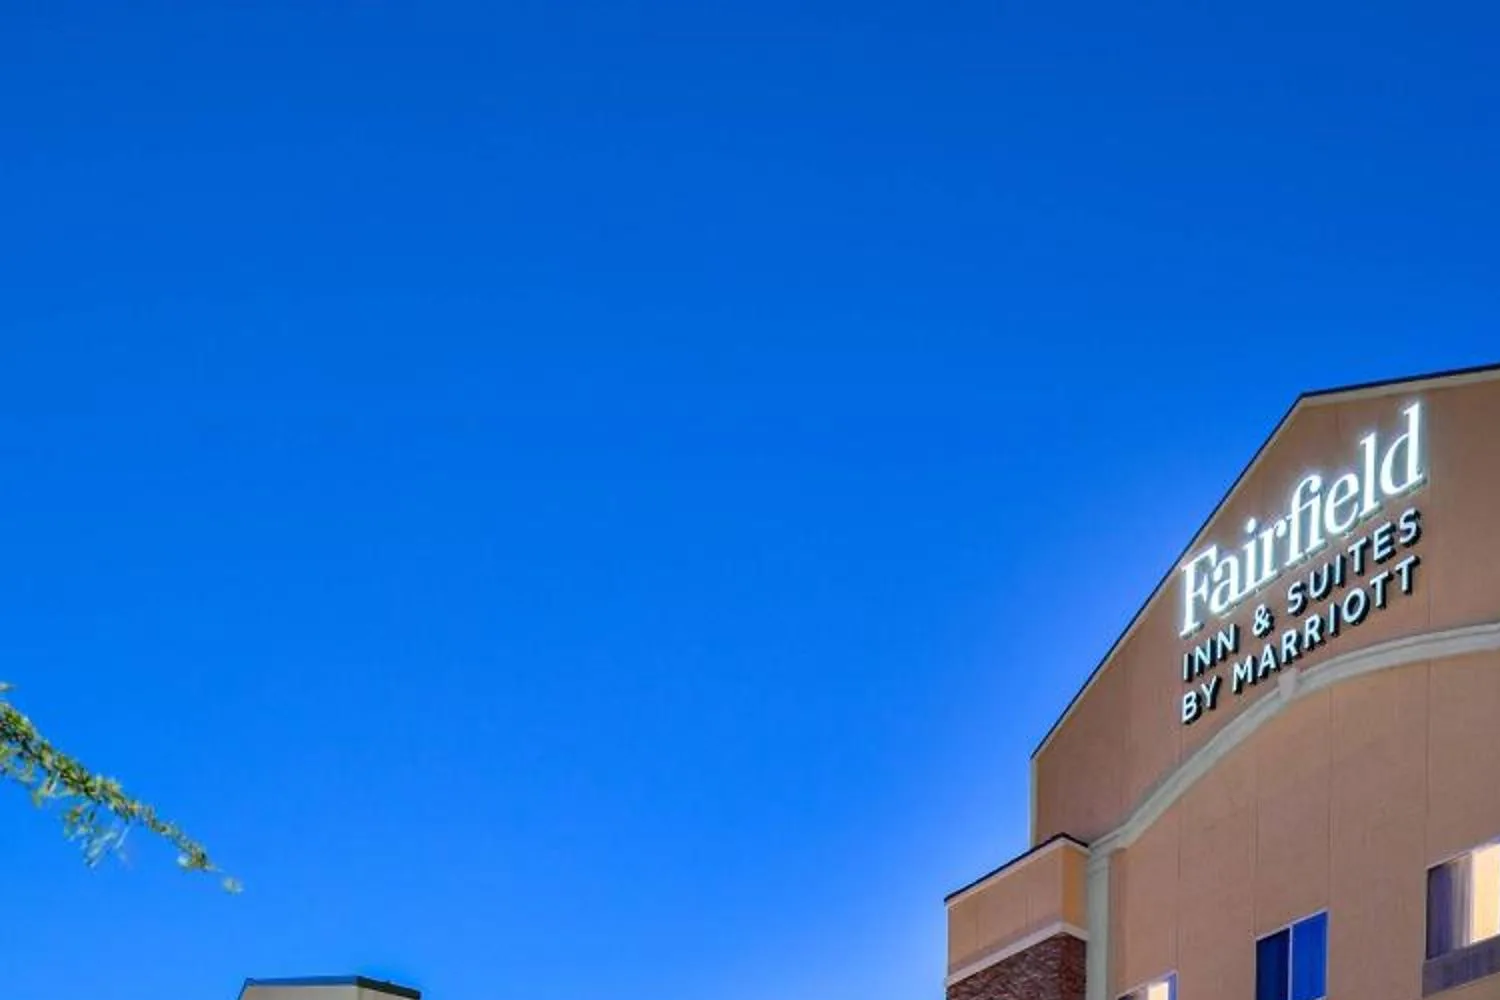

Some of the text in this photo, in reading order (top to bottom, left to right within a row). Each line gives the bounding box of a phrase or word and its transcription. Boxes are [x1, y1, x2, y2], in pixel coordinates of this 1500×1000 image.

[1180, 402, 1424, 638] Fairfield
[1182, 508, 1421, 681] INN & SUITES
[1181, 555, 1420, 724] BY MARRIOTT
